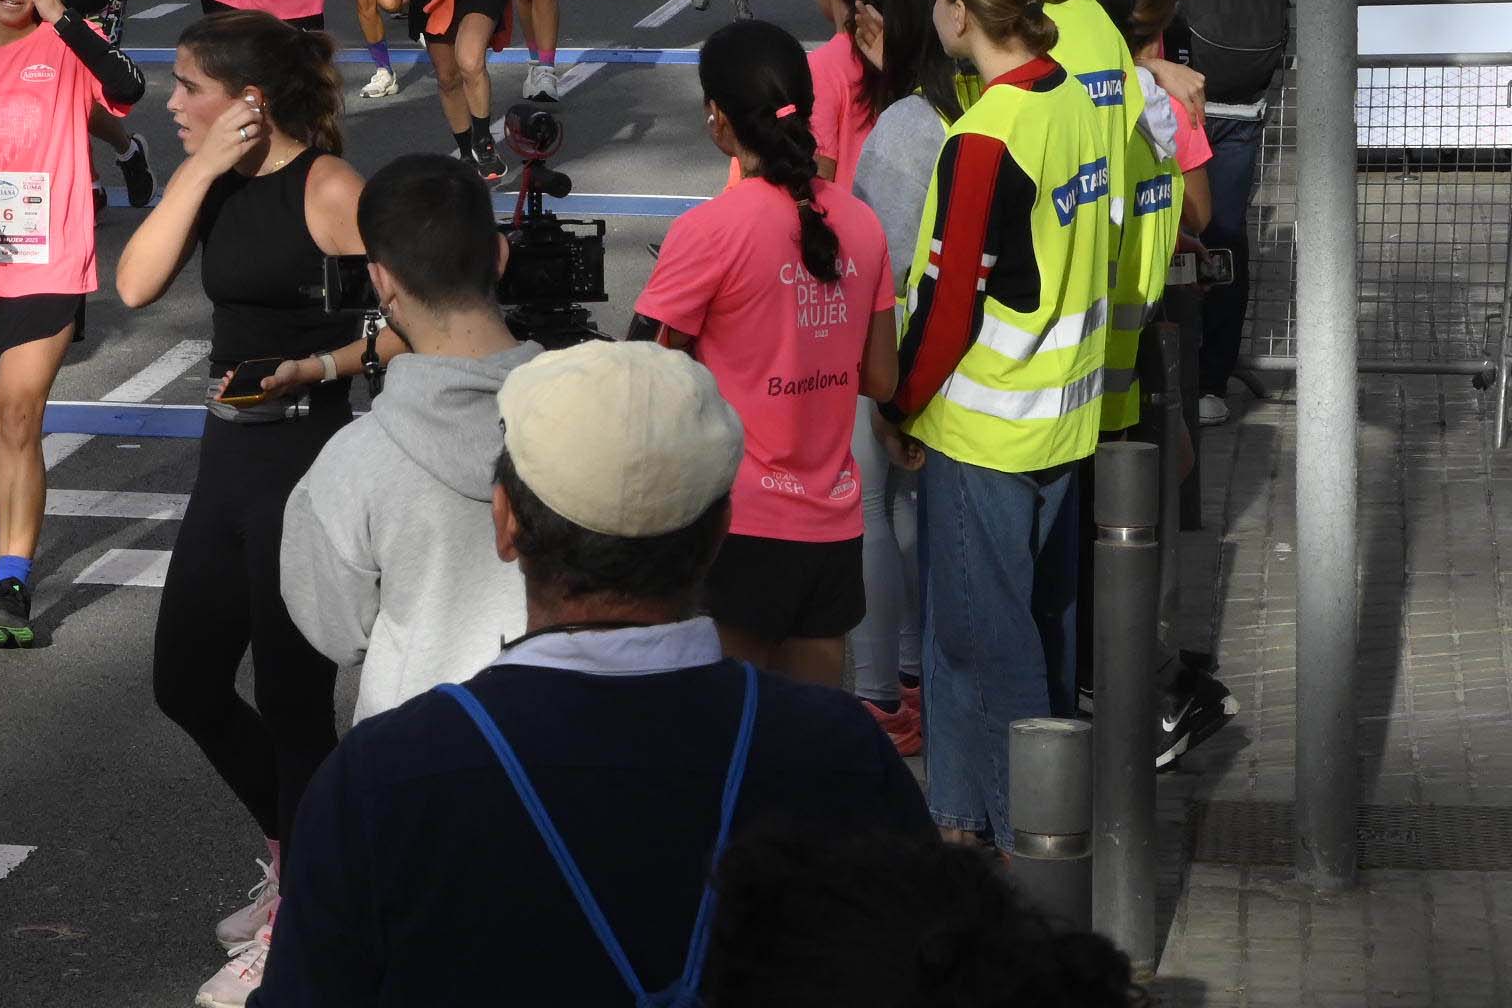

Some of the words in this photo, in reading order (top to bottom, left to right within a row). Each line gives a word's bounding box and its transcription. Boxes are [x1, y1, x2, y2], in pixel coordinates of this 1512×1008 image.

[1084, 78, 1123, 99] LUNTA
[779, 257, 858, 285] CARA
[797, 284, 818, 305] DE
[823, 282, 844, 303] LA
[797, 303, 848, 328] MUJER
[767, 368, 849, 398] Barcelona
